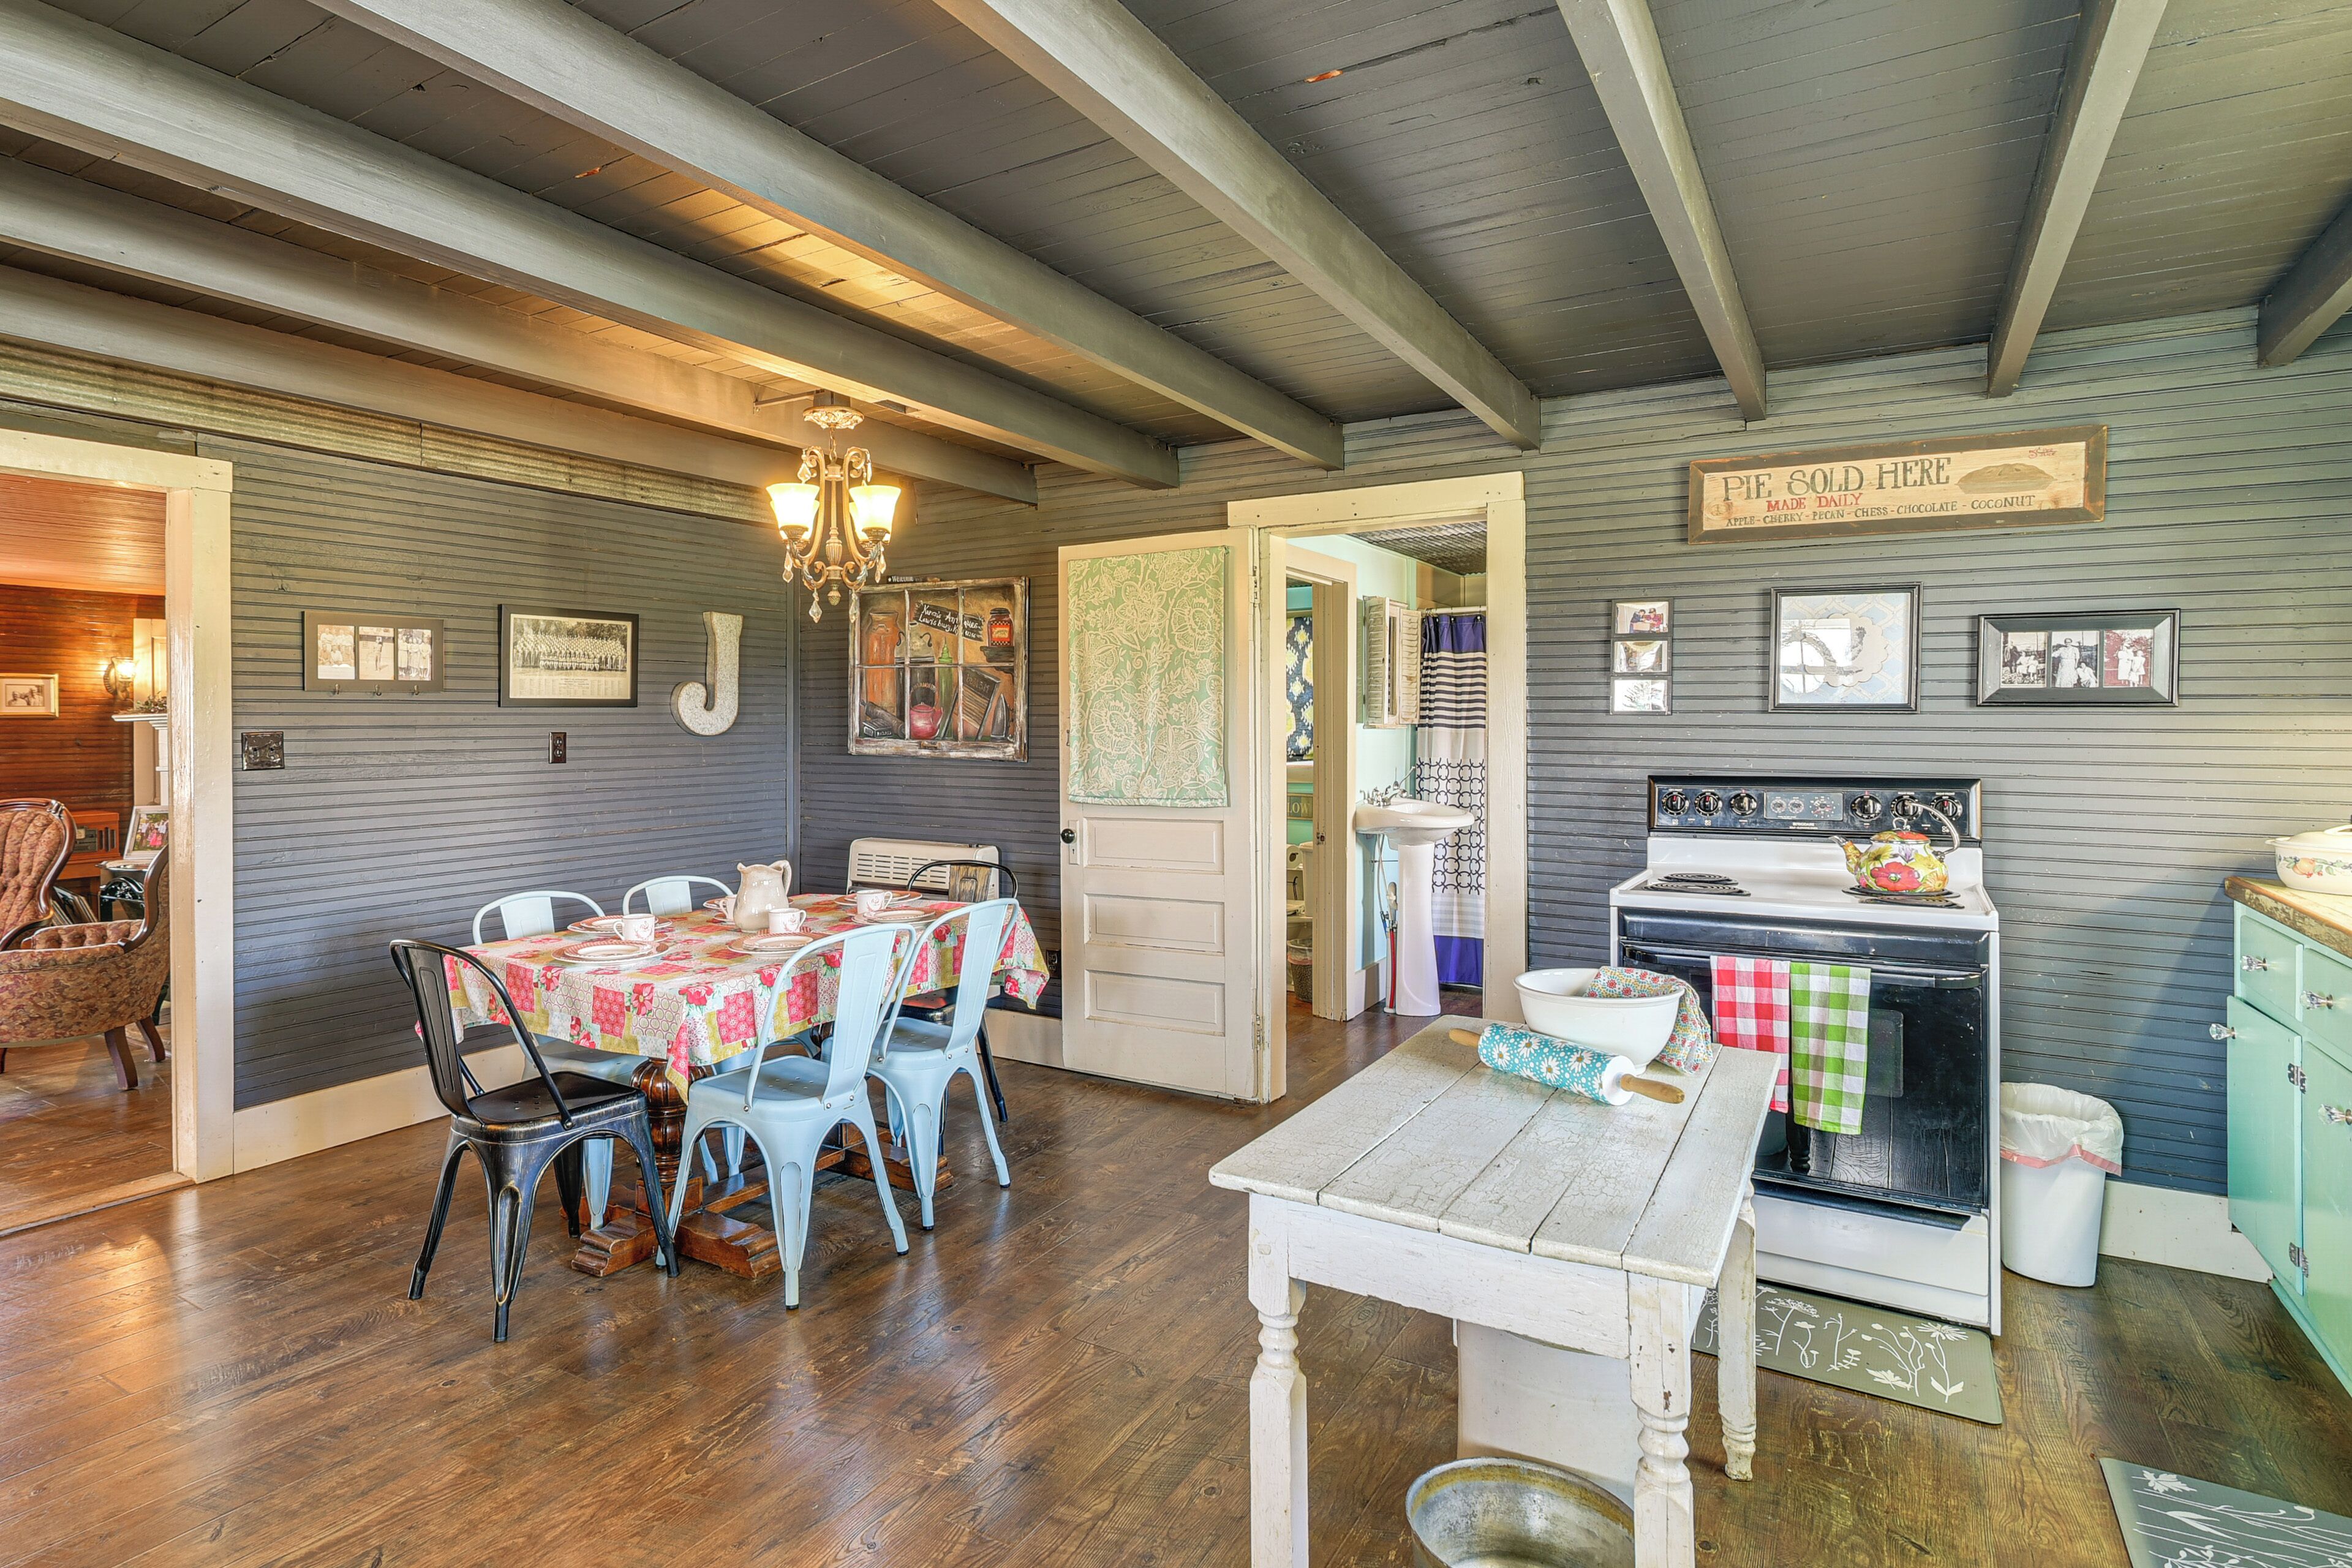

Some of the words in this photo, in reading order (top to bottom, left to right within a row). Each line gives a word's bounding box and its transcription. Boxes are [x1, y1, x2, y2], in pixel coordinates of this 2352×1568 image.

[1722, 473, 1772, 502] PIE
[1786, 465, 1864, 496] SOLD
[1875, 457, 1951, 490] HERE
[1726, 516, 1755, 527] APPLE
[1763, 511, 1804, 524] CHERRY
[1812, 509, 1845, 521] PECAN
[1854, 507, 1888, 518] CHESS
[1896, 501, 1958, 514] CHOCOLATE
[1970, 495, 2036, 510] COCONUT
[1766, 497, 1806, 512] MADE
[1817, 492, 1863, 508] DAILY
[670, 611, 744, 736] J
